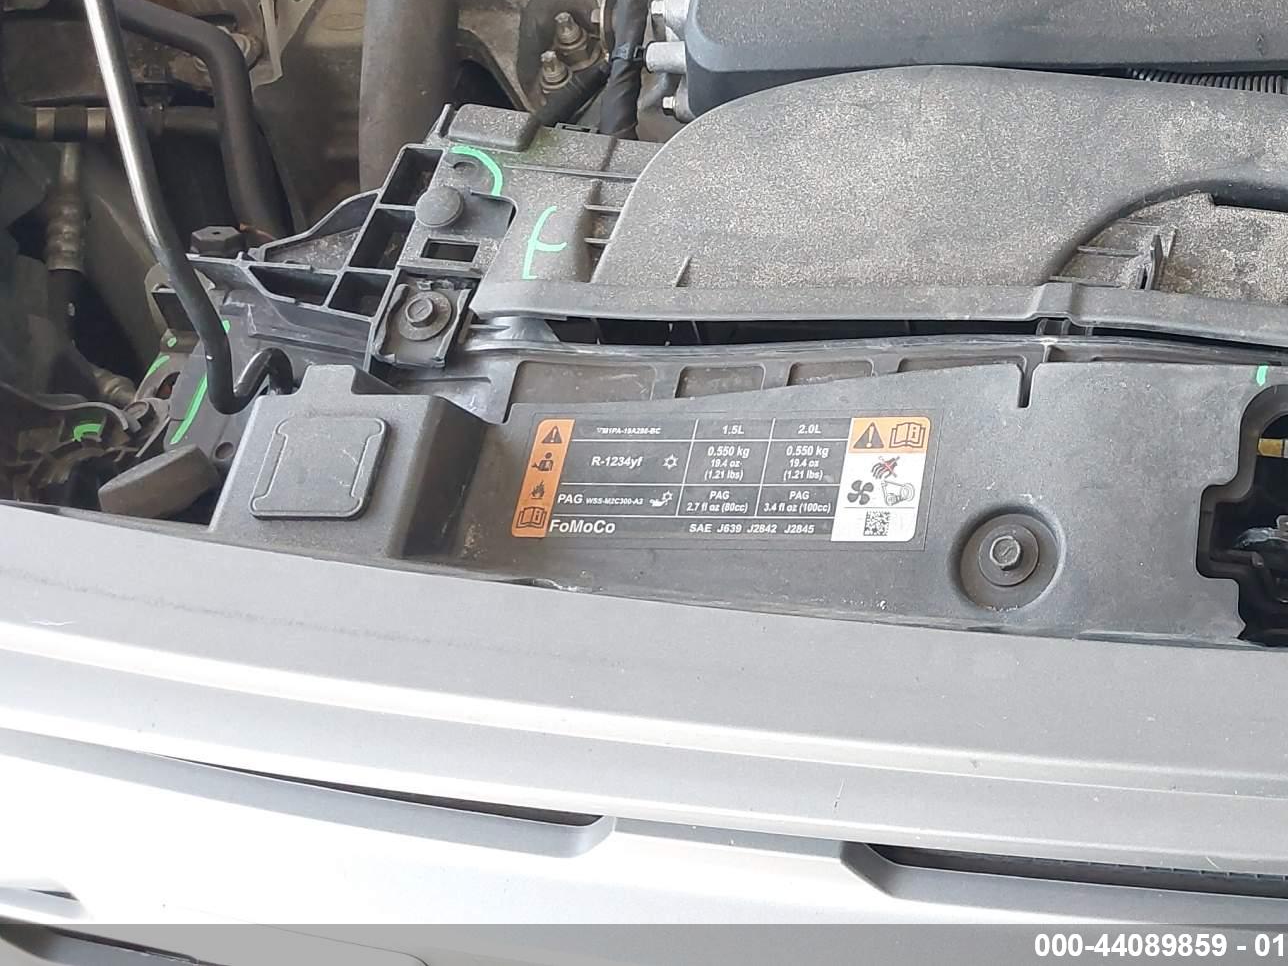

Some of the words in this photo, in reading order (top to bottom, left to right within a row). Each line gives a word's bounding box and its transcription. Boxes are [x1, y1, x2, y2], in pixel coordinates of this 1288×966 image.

[722, 425, 745, 435] 1.5L
[798, 424, 821, 434] 2.0L
[708, 446, 735, 457] 0.550
[736, 446, 750, 459] kg
[786, 446, 814, 457] 0.550
[815, 446, 829, 459] kg
[591, 455, 644, 469] R-1234yf
[711, 459, 728, 468] 19.4
[789, 459, 806, 468] 19.4
[704, 470, 726, 481] (1.21
[727, 470, 744, 481] lbs)
[783, 470, 805, 481] (1.21
[806, 470, 823, 481] lbs)
[557, 493, 583, 504] PAG
[709, 491, 730, 500] PAG
[789, 491, 810, 500] PAG
[686, 502, 699, 512] 2.7
[700, 502, 708, 512] fl
[709, 504, 720, 512] oz
[721, 502, 749, 514] (80cc)
[764, 502, 777, 512] 3.4
[778, 502, 786, 512] fl
[787, 504, 798, 512] oz
[799, 502, 831, 514] (100cc)
[549, 519, 616, 534] FoMoCo
[689, 523, 712, 533] SAE
[716, 523, 743, 534] J639
[746, 523, 778, 534] J2842
[783, 524, 815, 534] J2845
